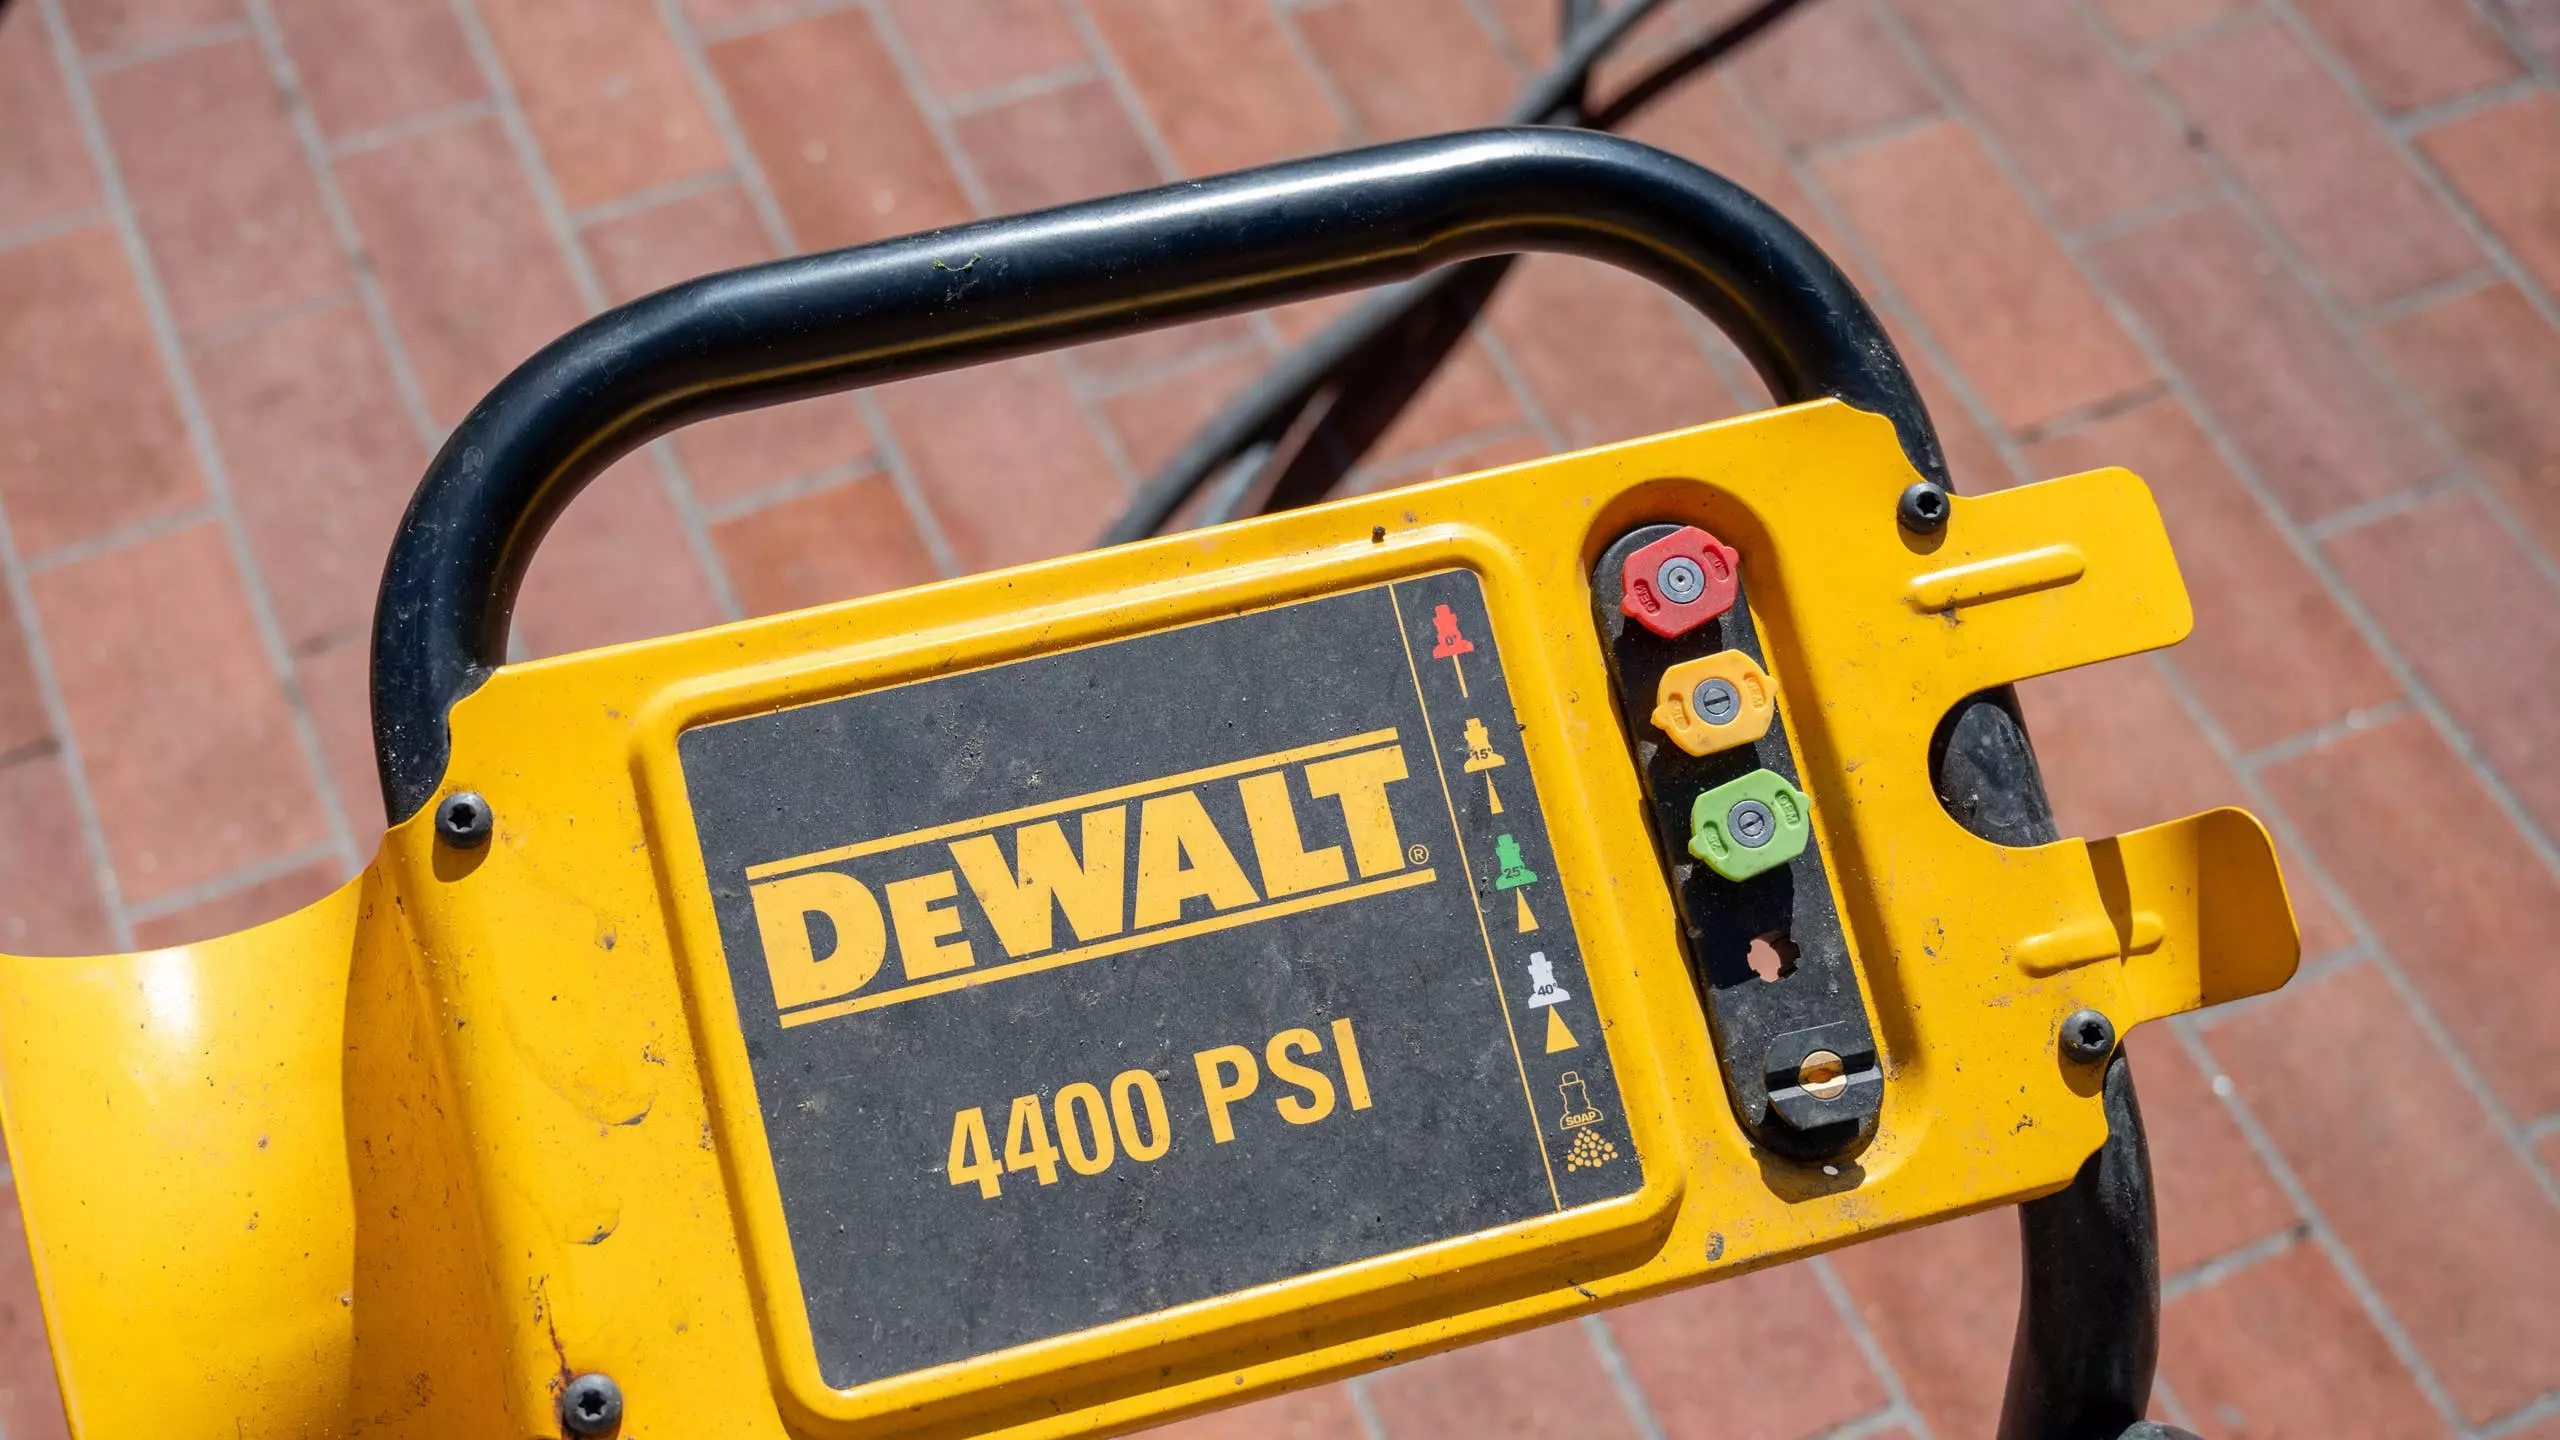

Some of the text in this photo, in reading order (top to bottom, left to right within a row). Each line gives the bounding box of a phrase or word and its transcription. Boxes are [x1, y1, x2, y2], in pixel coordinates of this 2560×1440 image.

[1778, 795, 1798, 825] OEM
[947, 1018, 1372, 1199] 4400 PSI
[1565, 1110, 1597, 1126] SOAP
